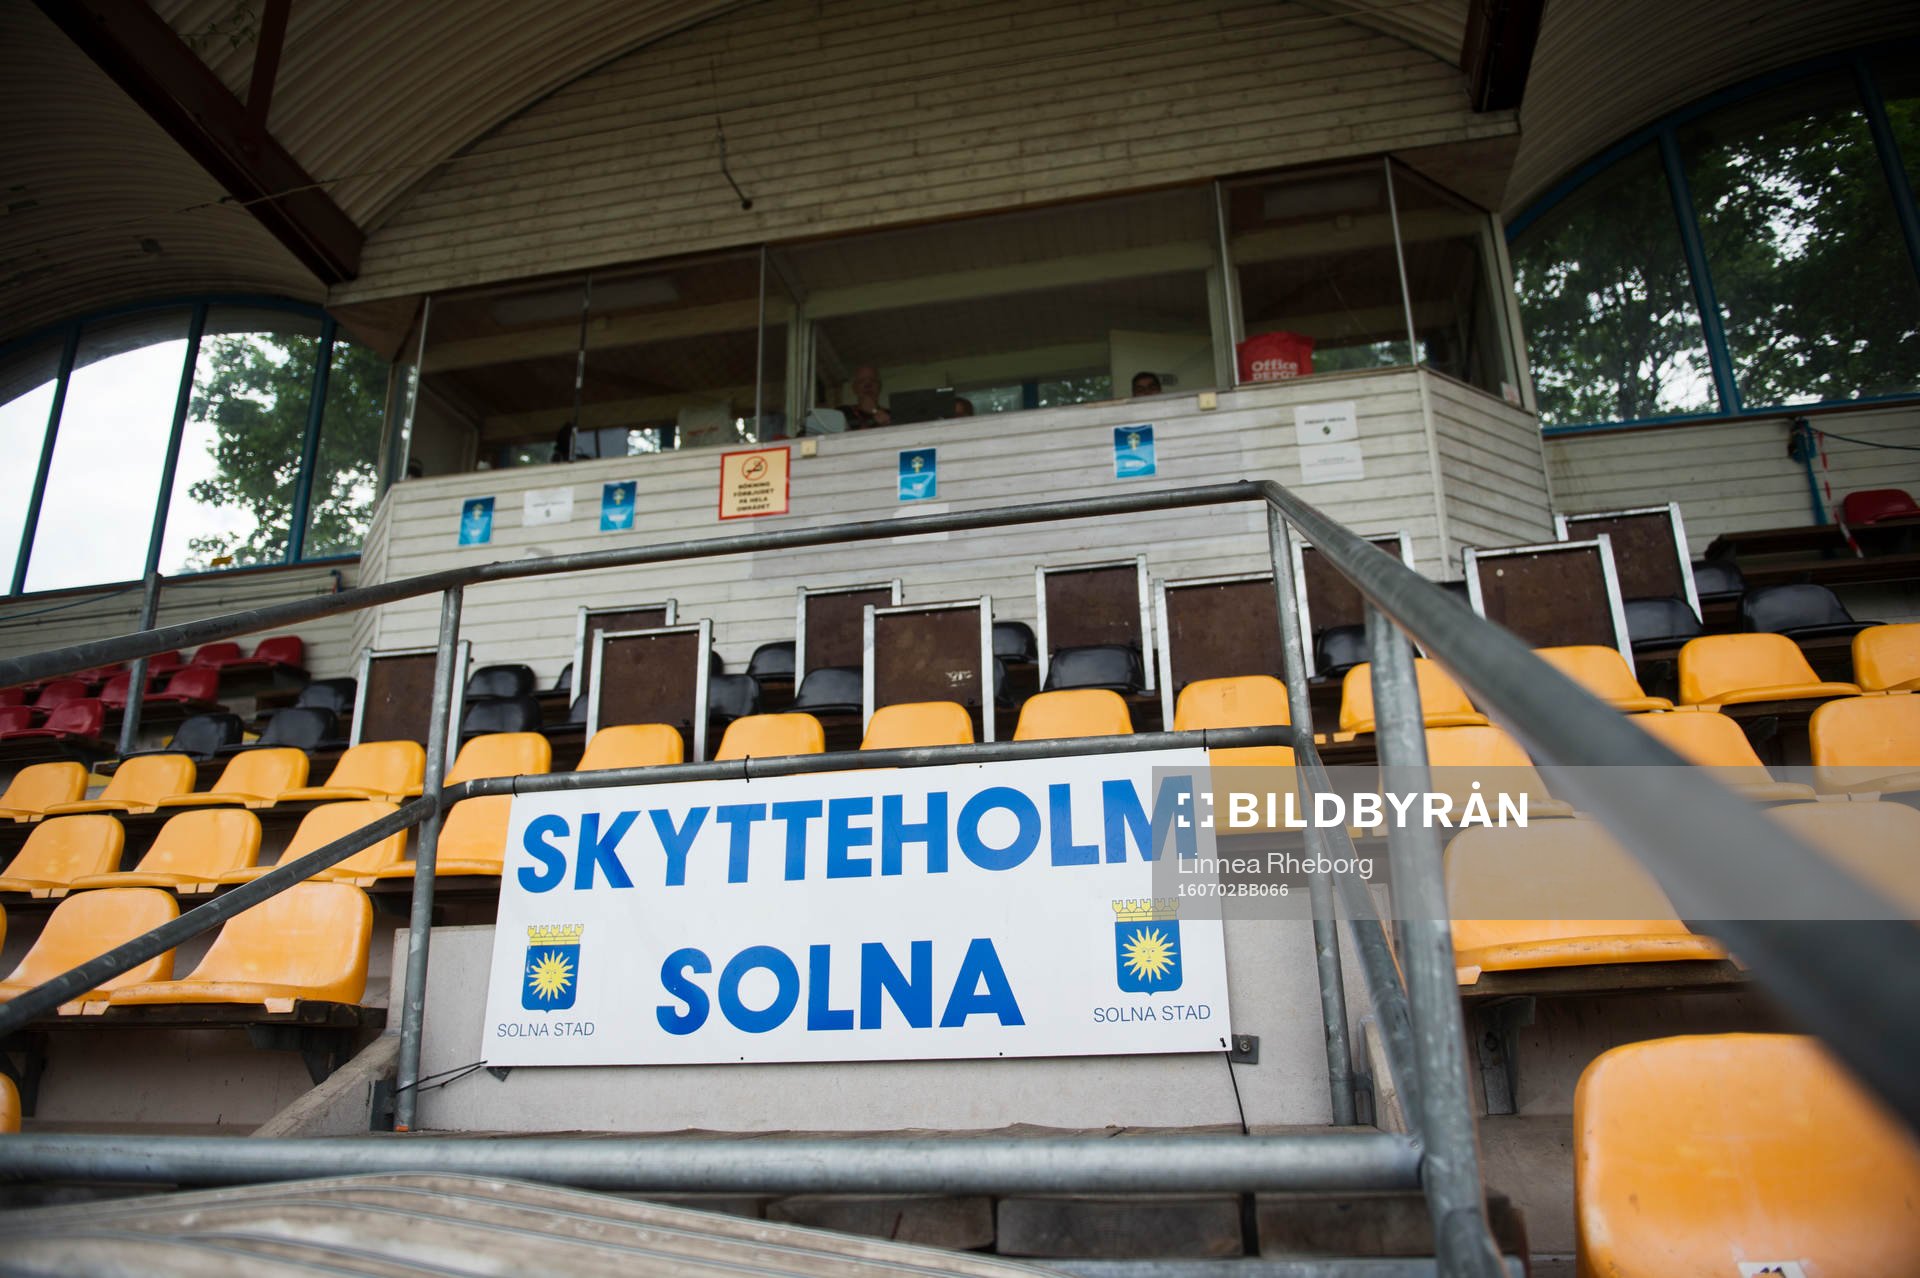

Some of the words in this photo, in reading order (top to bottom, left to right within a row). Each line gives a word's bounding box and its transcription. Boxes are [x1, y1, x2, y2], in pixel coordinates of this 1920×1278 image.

[1251, 358, 1298, 372] Office
[517, 775, 1197, 893] SKYTTEHOLM
[656, 938, 1026, 1035] SOLNA
[1093, 1006, 1156, 1023] SOLNA
[1162, 1004, 1211, 1021] STAD
[497, 1023, 549, 1037] SOLNA
[554, 1022, 595, 1036] STAD
